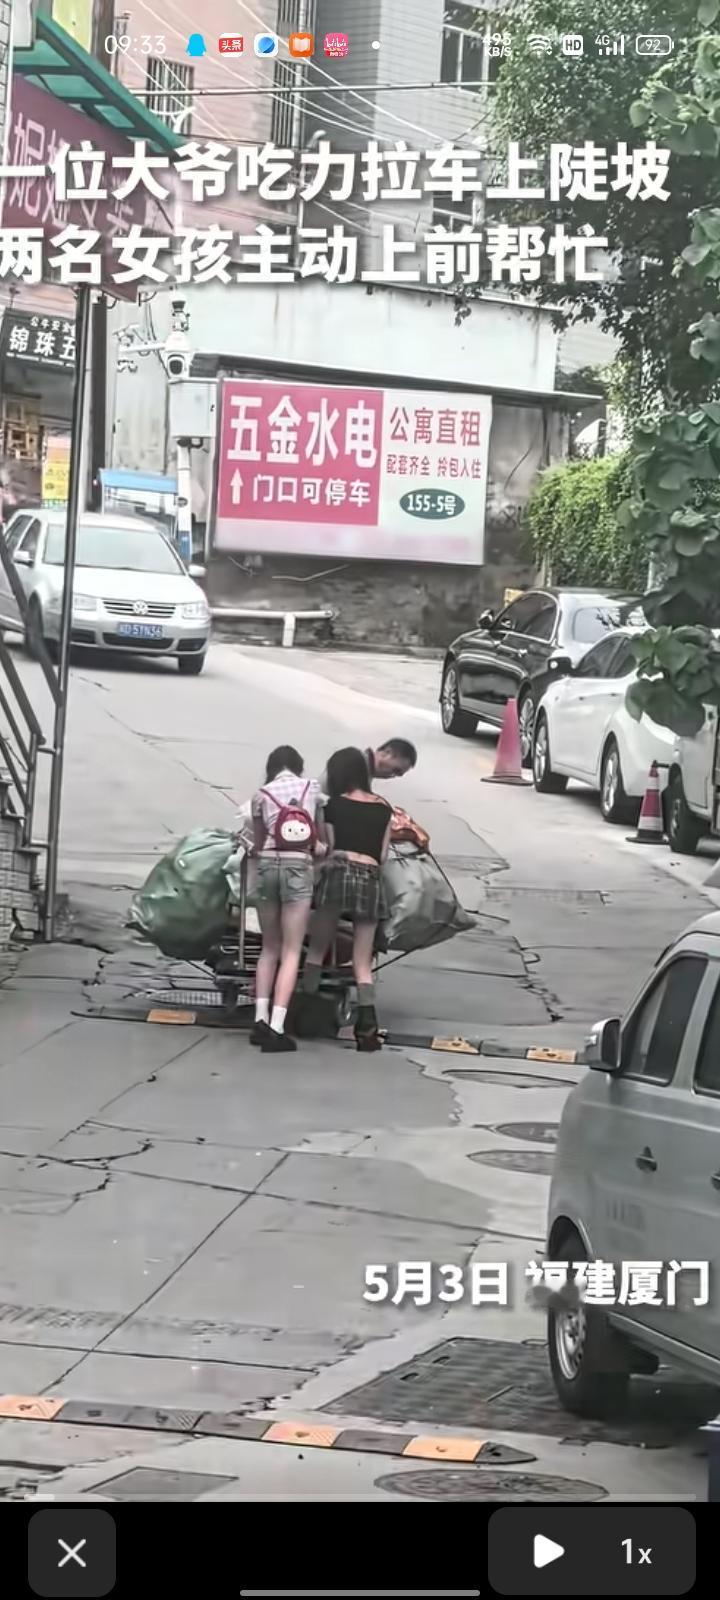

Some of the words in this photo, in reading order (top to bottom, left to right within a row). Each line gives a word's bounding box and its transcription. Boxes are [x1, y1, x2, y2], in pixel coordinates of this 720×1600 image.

[227, 395, 378, 468] 五金水电
[389, 406, 481, 446] 公寓直租
[386, 454, 430, 476] 配套齐全
[437, 457, 482, 479] 拎包入住
[252, 474, 371, 507] 门口可停车
[407, 494, 457, 516] 155-5号
